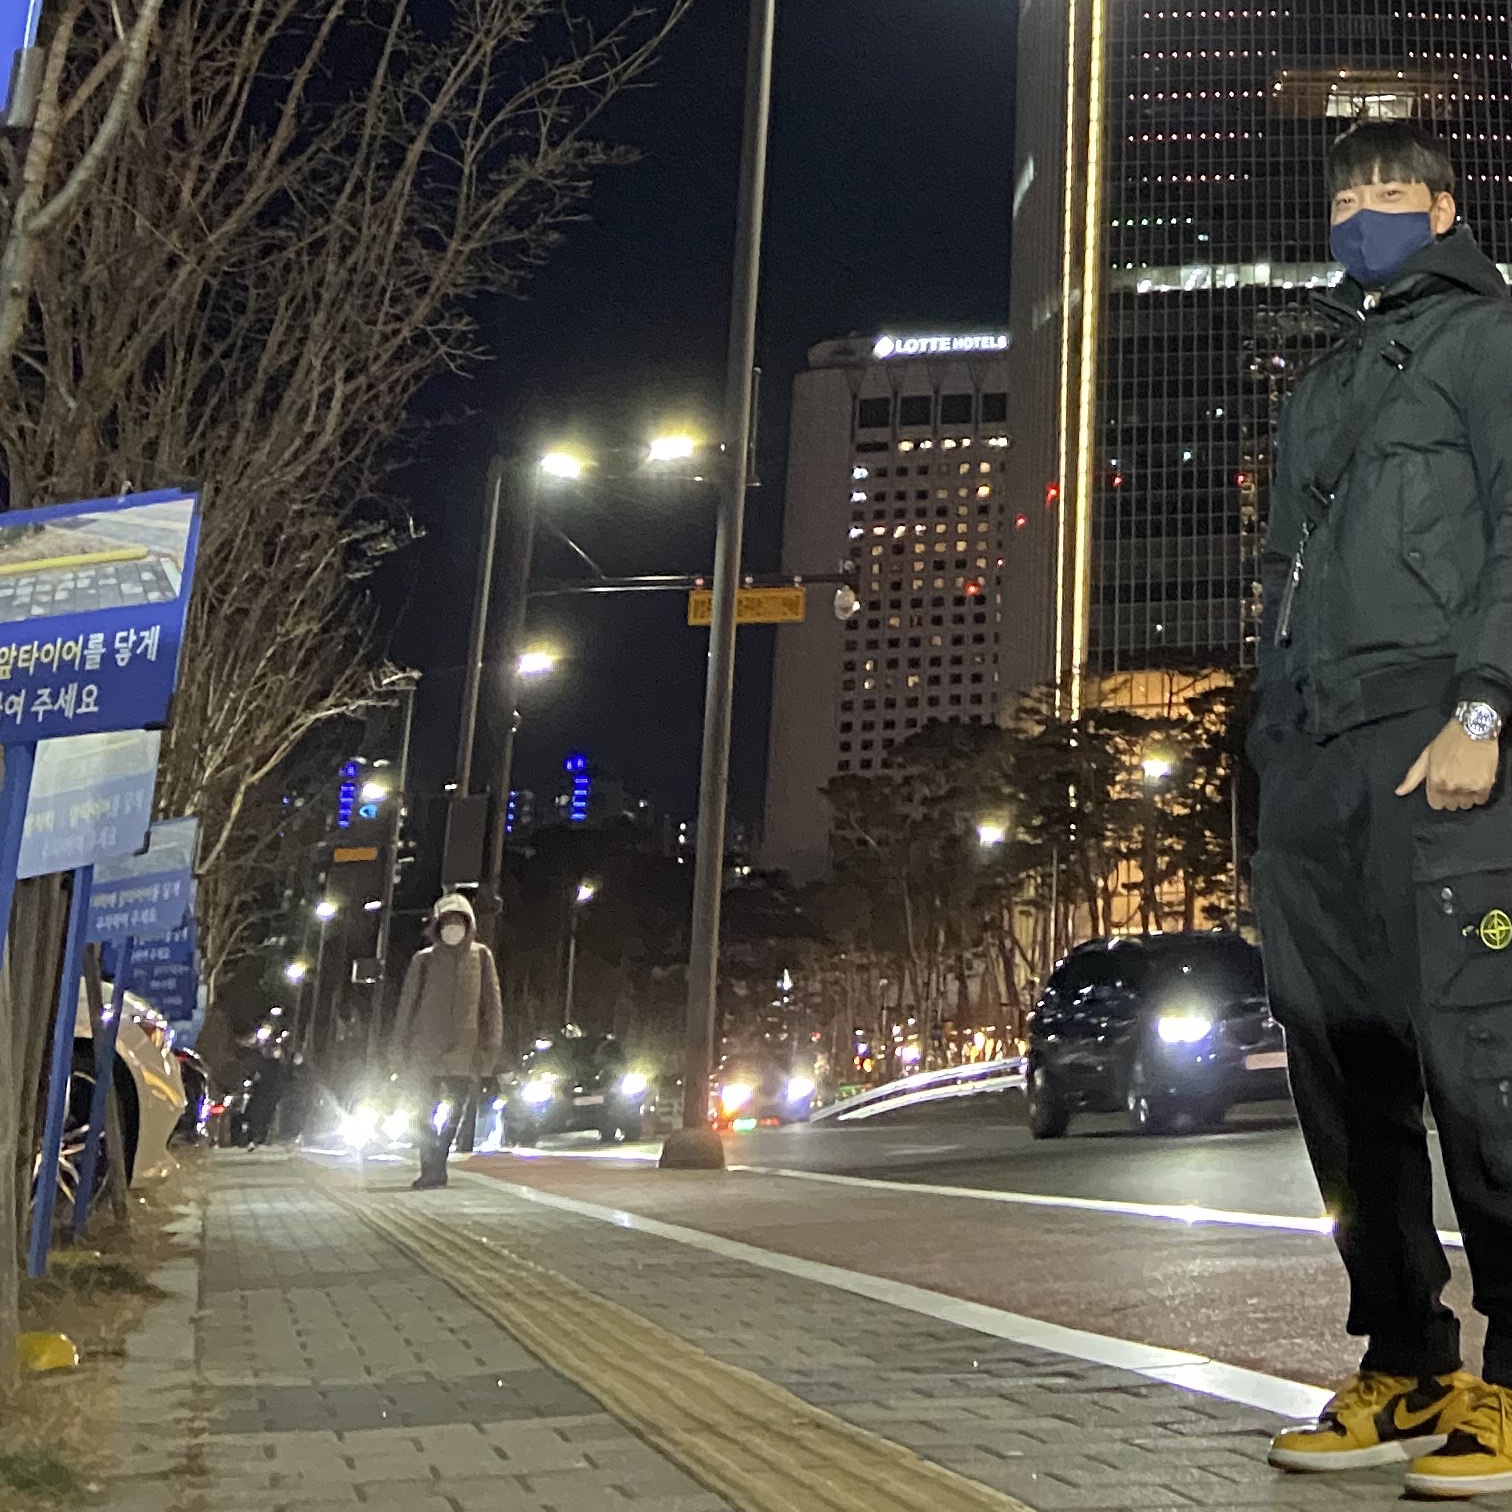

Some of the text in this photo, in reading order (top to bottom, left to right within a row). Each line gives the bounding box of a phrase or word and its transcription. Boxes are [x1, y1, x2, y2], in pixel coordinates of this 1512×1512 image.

[895, 335, 1008, 353] LOTTE HOTELS
[0, 682, 100, 726] 여 주세요
